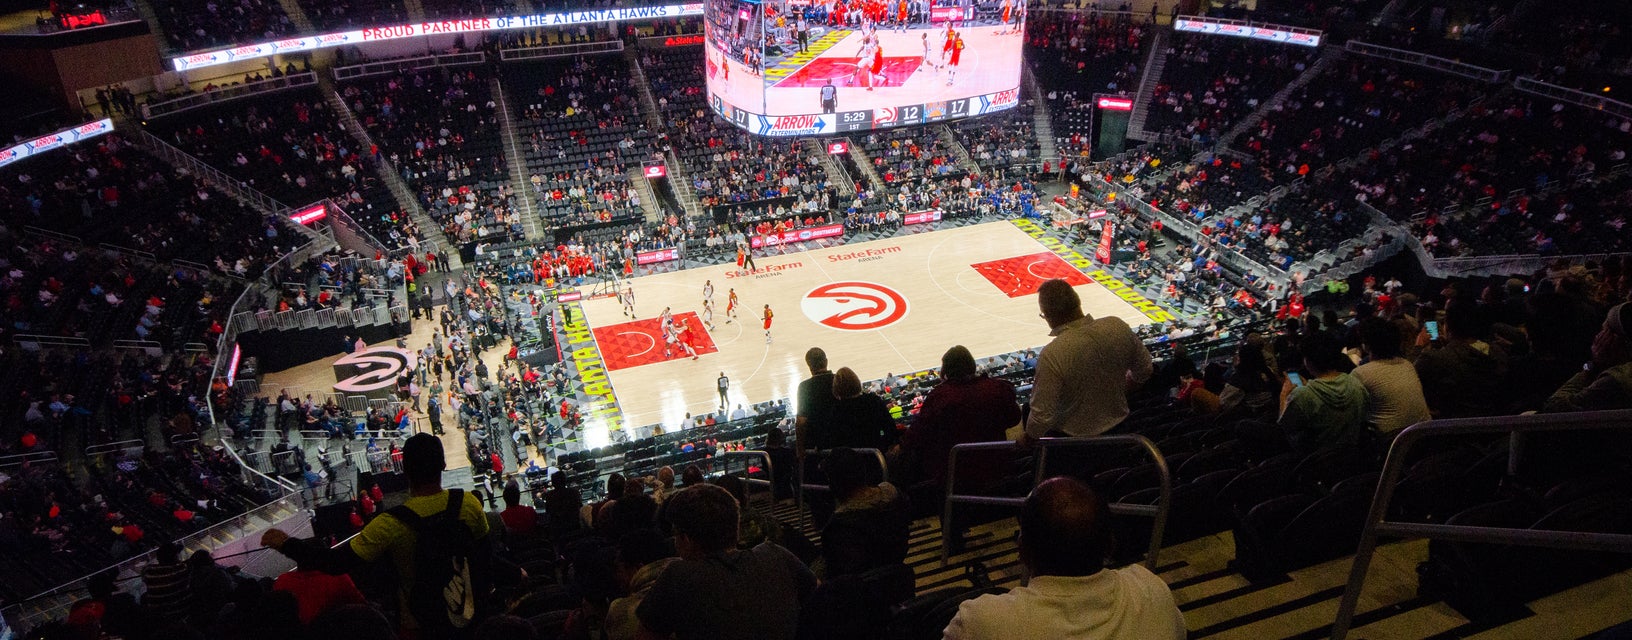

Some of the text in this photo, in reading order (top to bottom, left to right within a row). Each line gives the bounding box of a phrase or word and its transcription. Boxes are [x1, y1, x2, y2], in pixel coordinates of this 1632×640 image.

[363, 6, 667, 41] PROUD PARTNER OF THE ATLANTA HAWKS
[675, 36, 693, 45] State
[713, 96, 721, 110] 12
[951, 100, 966, 114] 17
[735, 109, 746, 124] 17
[843, 111, 866, 122] 5:29
[903, 106, 918, 120] 12
[773, 114, 817, 129] ARROW
[812, 227, 842, 236] SOUTHEAST
[755, 271, 783, 279] ARENA
[1010, 218, 1176, 323] ATLANTA HAWKS
